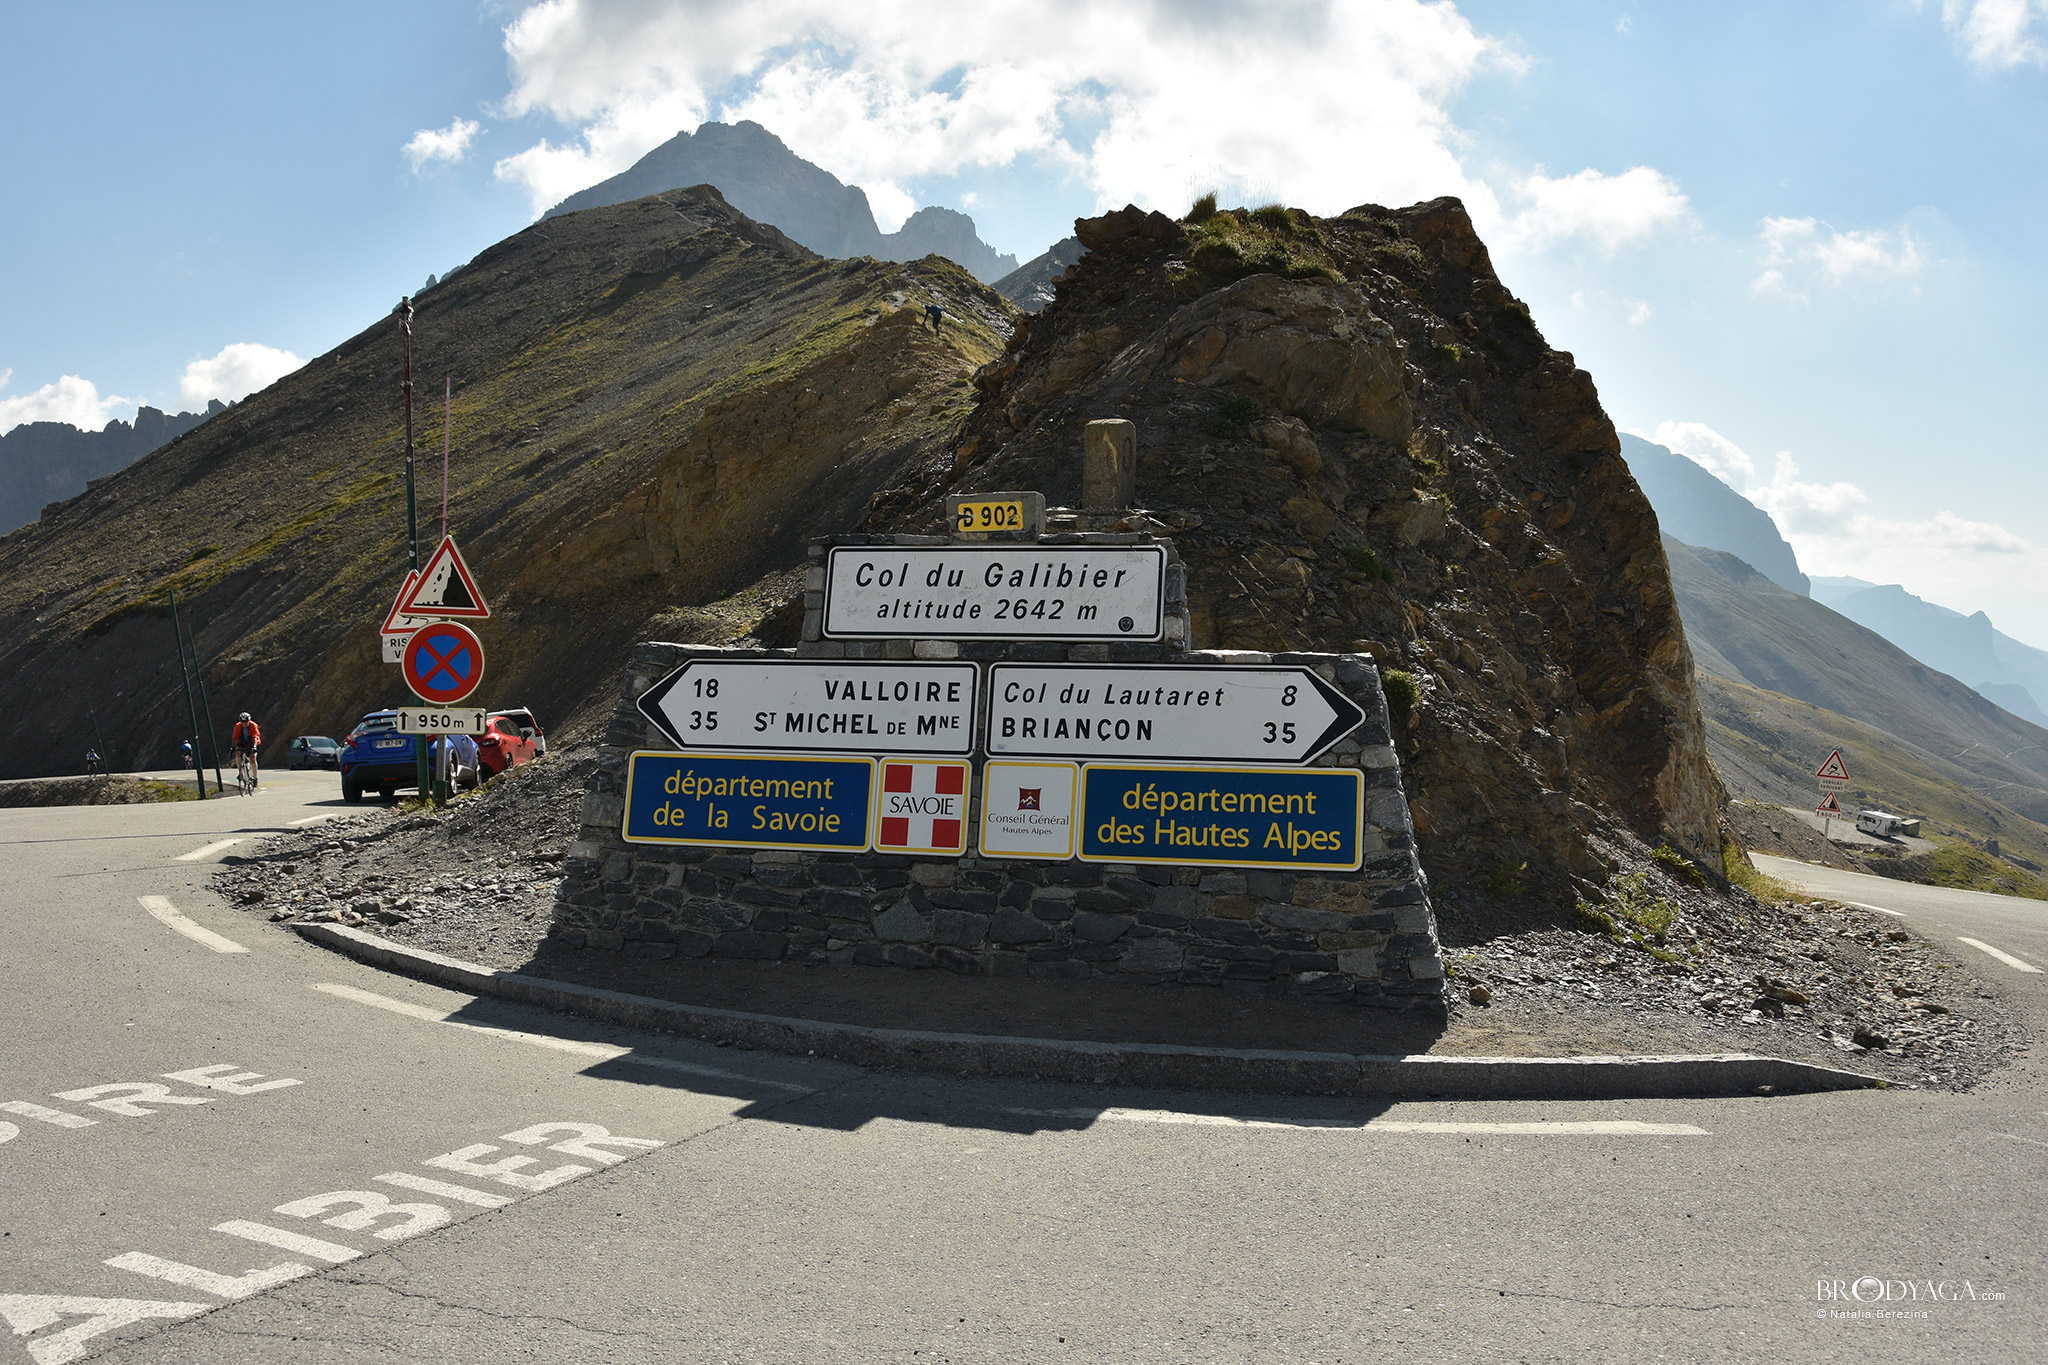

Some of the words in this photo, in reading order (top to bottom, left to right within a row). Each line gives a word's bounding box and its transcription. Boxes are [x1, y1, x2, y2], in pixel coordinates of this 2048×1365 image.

[962, 507, 973, 527] D
[981, 505, 1018, 526] 902
[856, 563, 908, 587] Col
[927, 563, 963, 587] du
[985, 563, 1126, 587] Galibier
[877, 599, 981, 619] altitude
[994, 599, 1064, 619] 2642
[1077, 605, 1097, 619] m
[694, 679, 718, 698] 18
[825, 681, 960, 702] VALLOIRE
[1005, 682, 1046, 703] Col
[1060, 684, 1090, 704] du
[1104, 684, 1224, 706] Lautaret
[1281, 685, 1297, 706] 8
[419, 715, 450, 727] 950
[690, 711, 717, 730] 35
[786, 713, 878, 734] MICHEL
[1002, 717, 1152, 741] BRIANÇON
[1263, 722, 1296, 743] 35
[665, 770, 834, 800] département
[889, 796, 954, 815] SAVOIE
[1123, 783, 1317, 816] département
[654, 801, 685, 826] de
[708, 802, 728, 828] la
[752, 806, 841, 833] Savoie
[988, 813, 1025, 823] Conseil
[1029, 814, 1069, 825] Général
[1098, 816, 1144, 844] des
[1155, 819, 1249, 847] Hautes
[1264, 823, 1341, 856] Alpes
[0, 1063, 304, 1143] IRE
